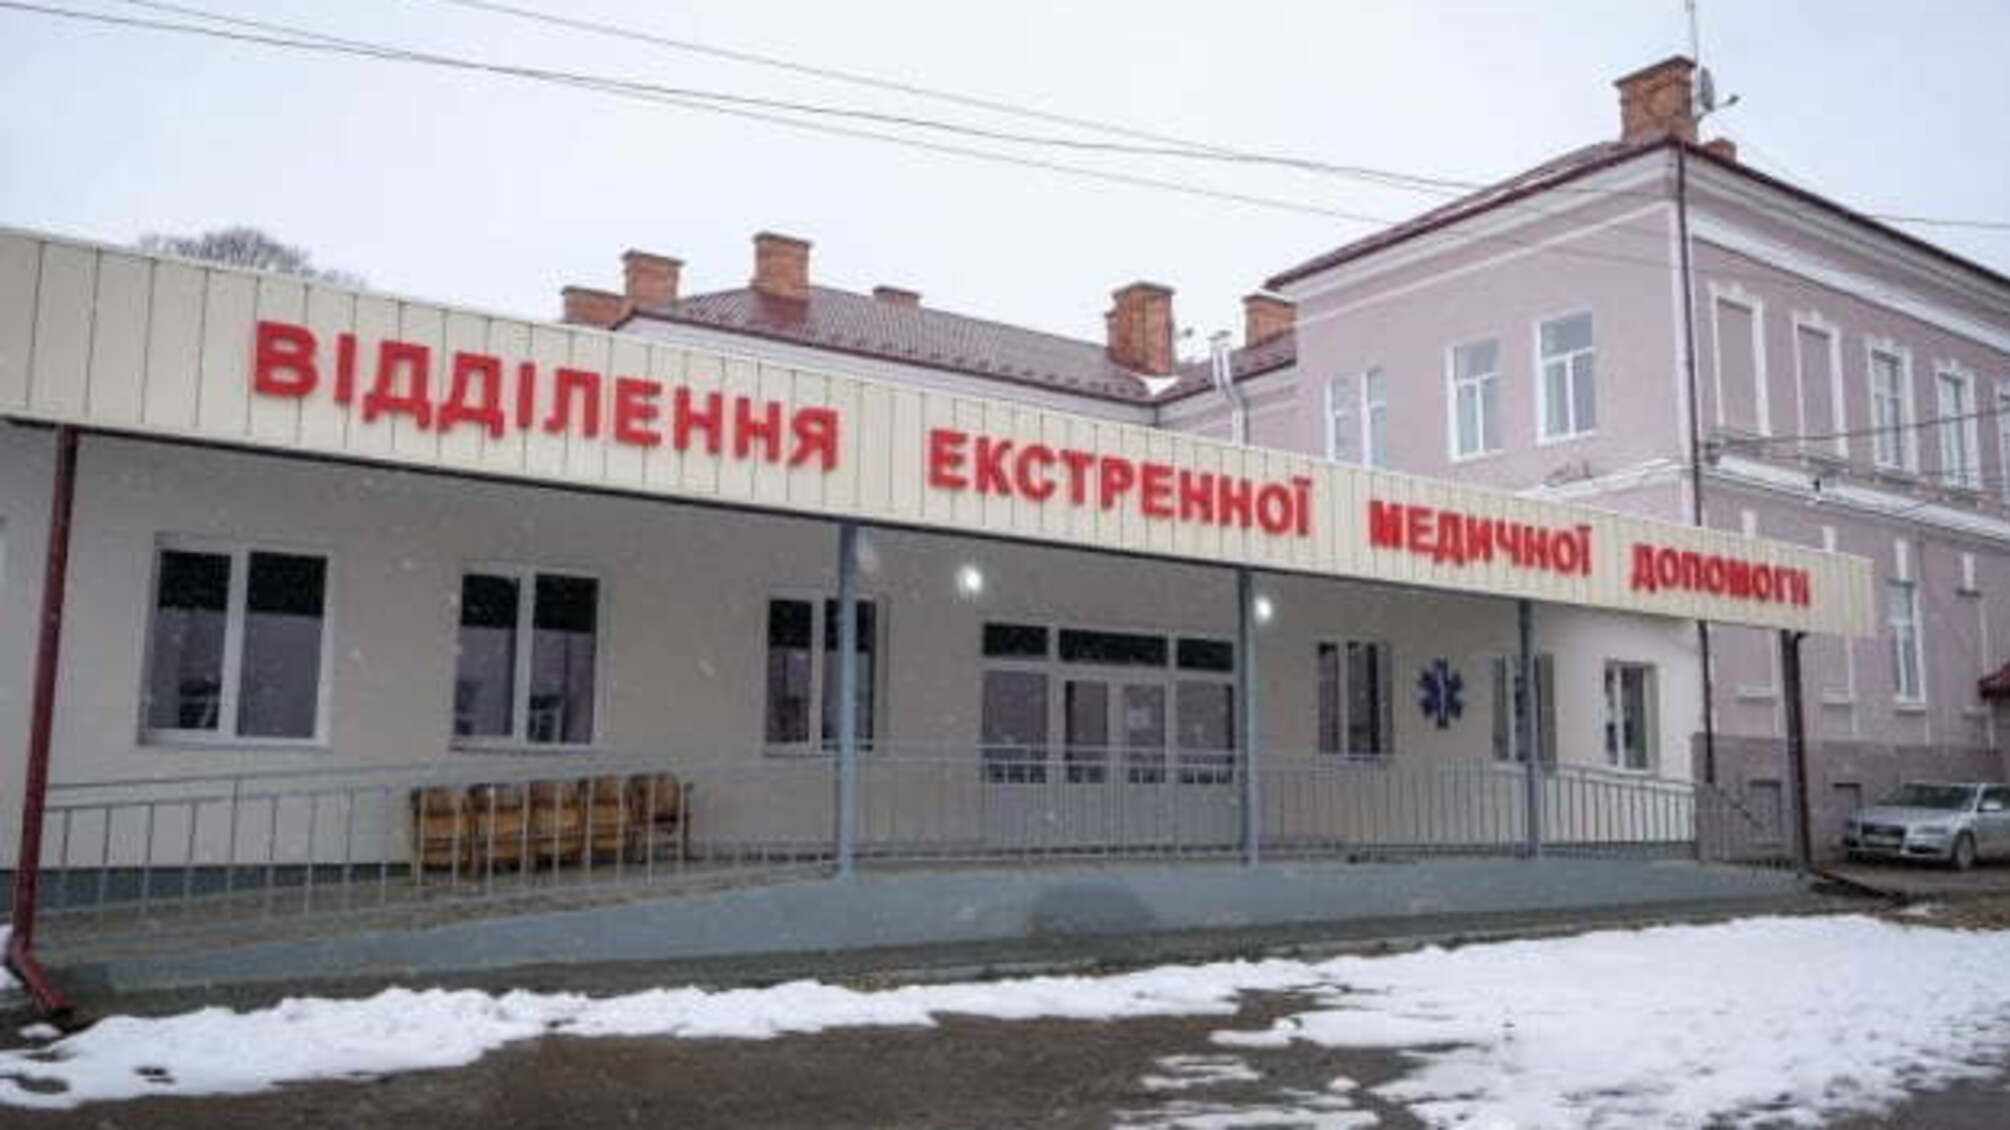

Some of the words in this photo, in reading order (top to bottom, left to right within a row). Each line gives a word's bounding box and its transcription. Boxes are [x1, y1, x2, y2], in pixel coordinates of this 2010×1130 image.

[252, 319, 840, 470] ВІДДІЛЕННЯ
[926, 428, 1312, 537] ЕКСТРЕННОЇ
[1367, 499, 1592, 576] МЕДИЧНОЇ
[1631, 543, 1810, 606] ДОПОМОГИ
